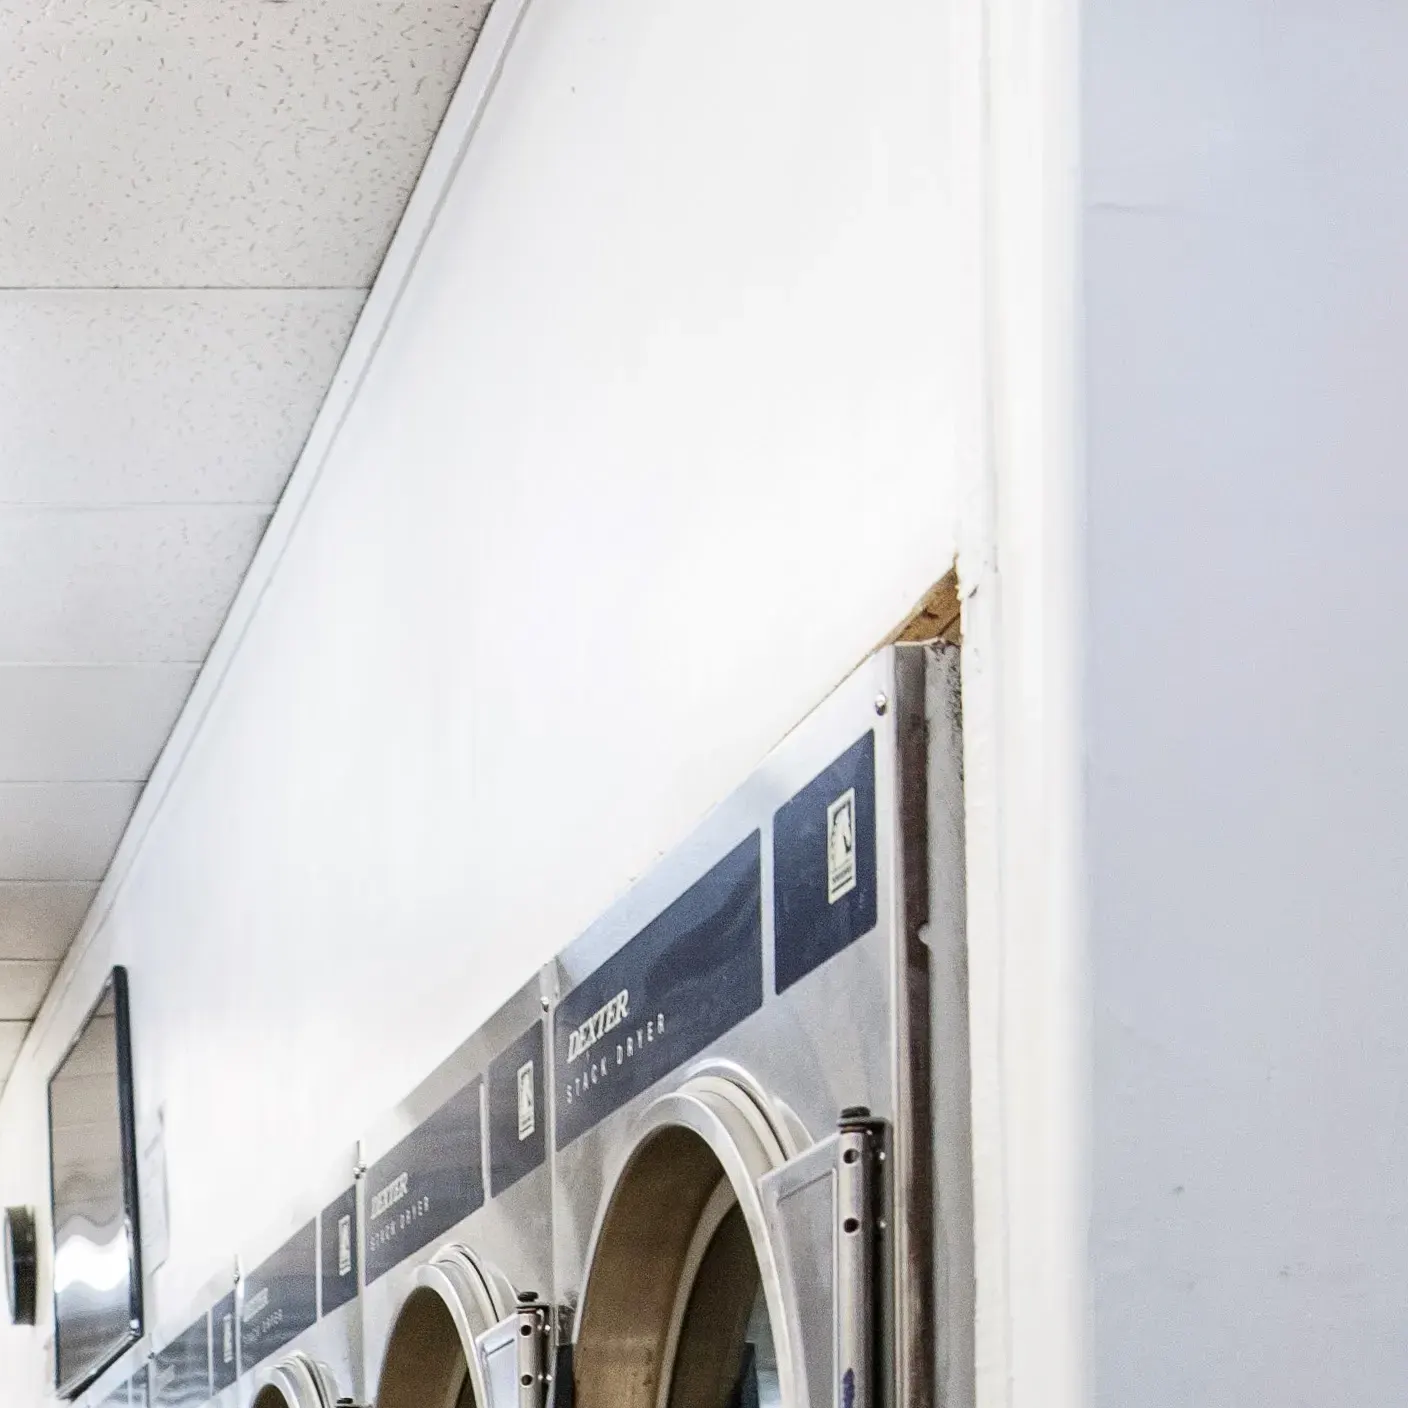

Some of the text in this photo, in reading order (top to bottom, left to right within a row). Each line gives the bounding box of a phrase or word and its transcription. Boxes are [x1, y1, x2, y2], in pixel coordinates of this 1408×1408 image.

[566, 1012, 665, 1104] STACK DRYER
[567, 989, 629, 1063] DEXTER
[370, 1172, 408, 1220] DEXTER
